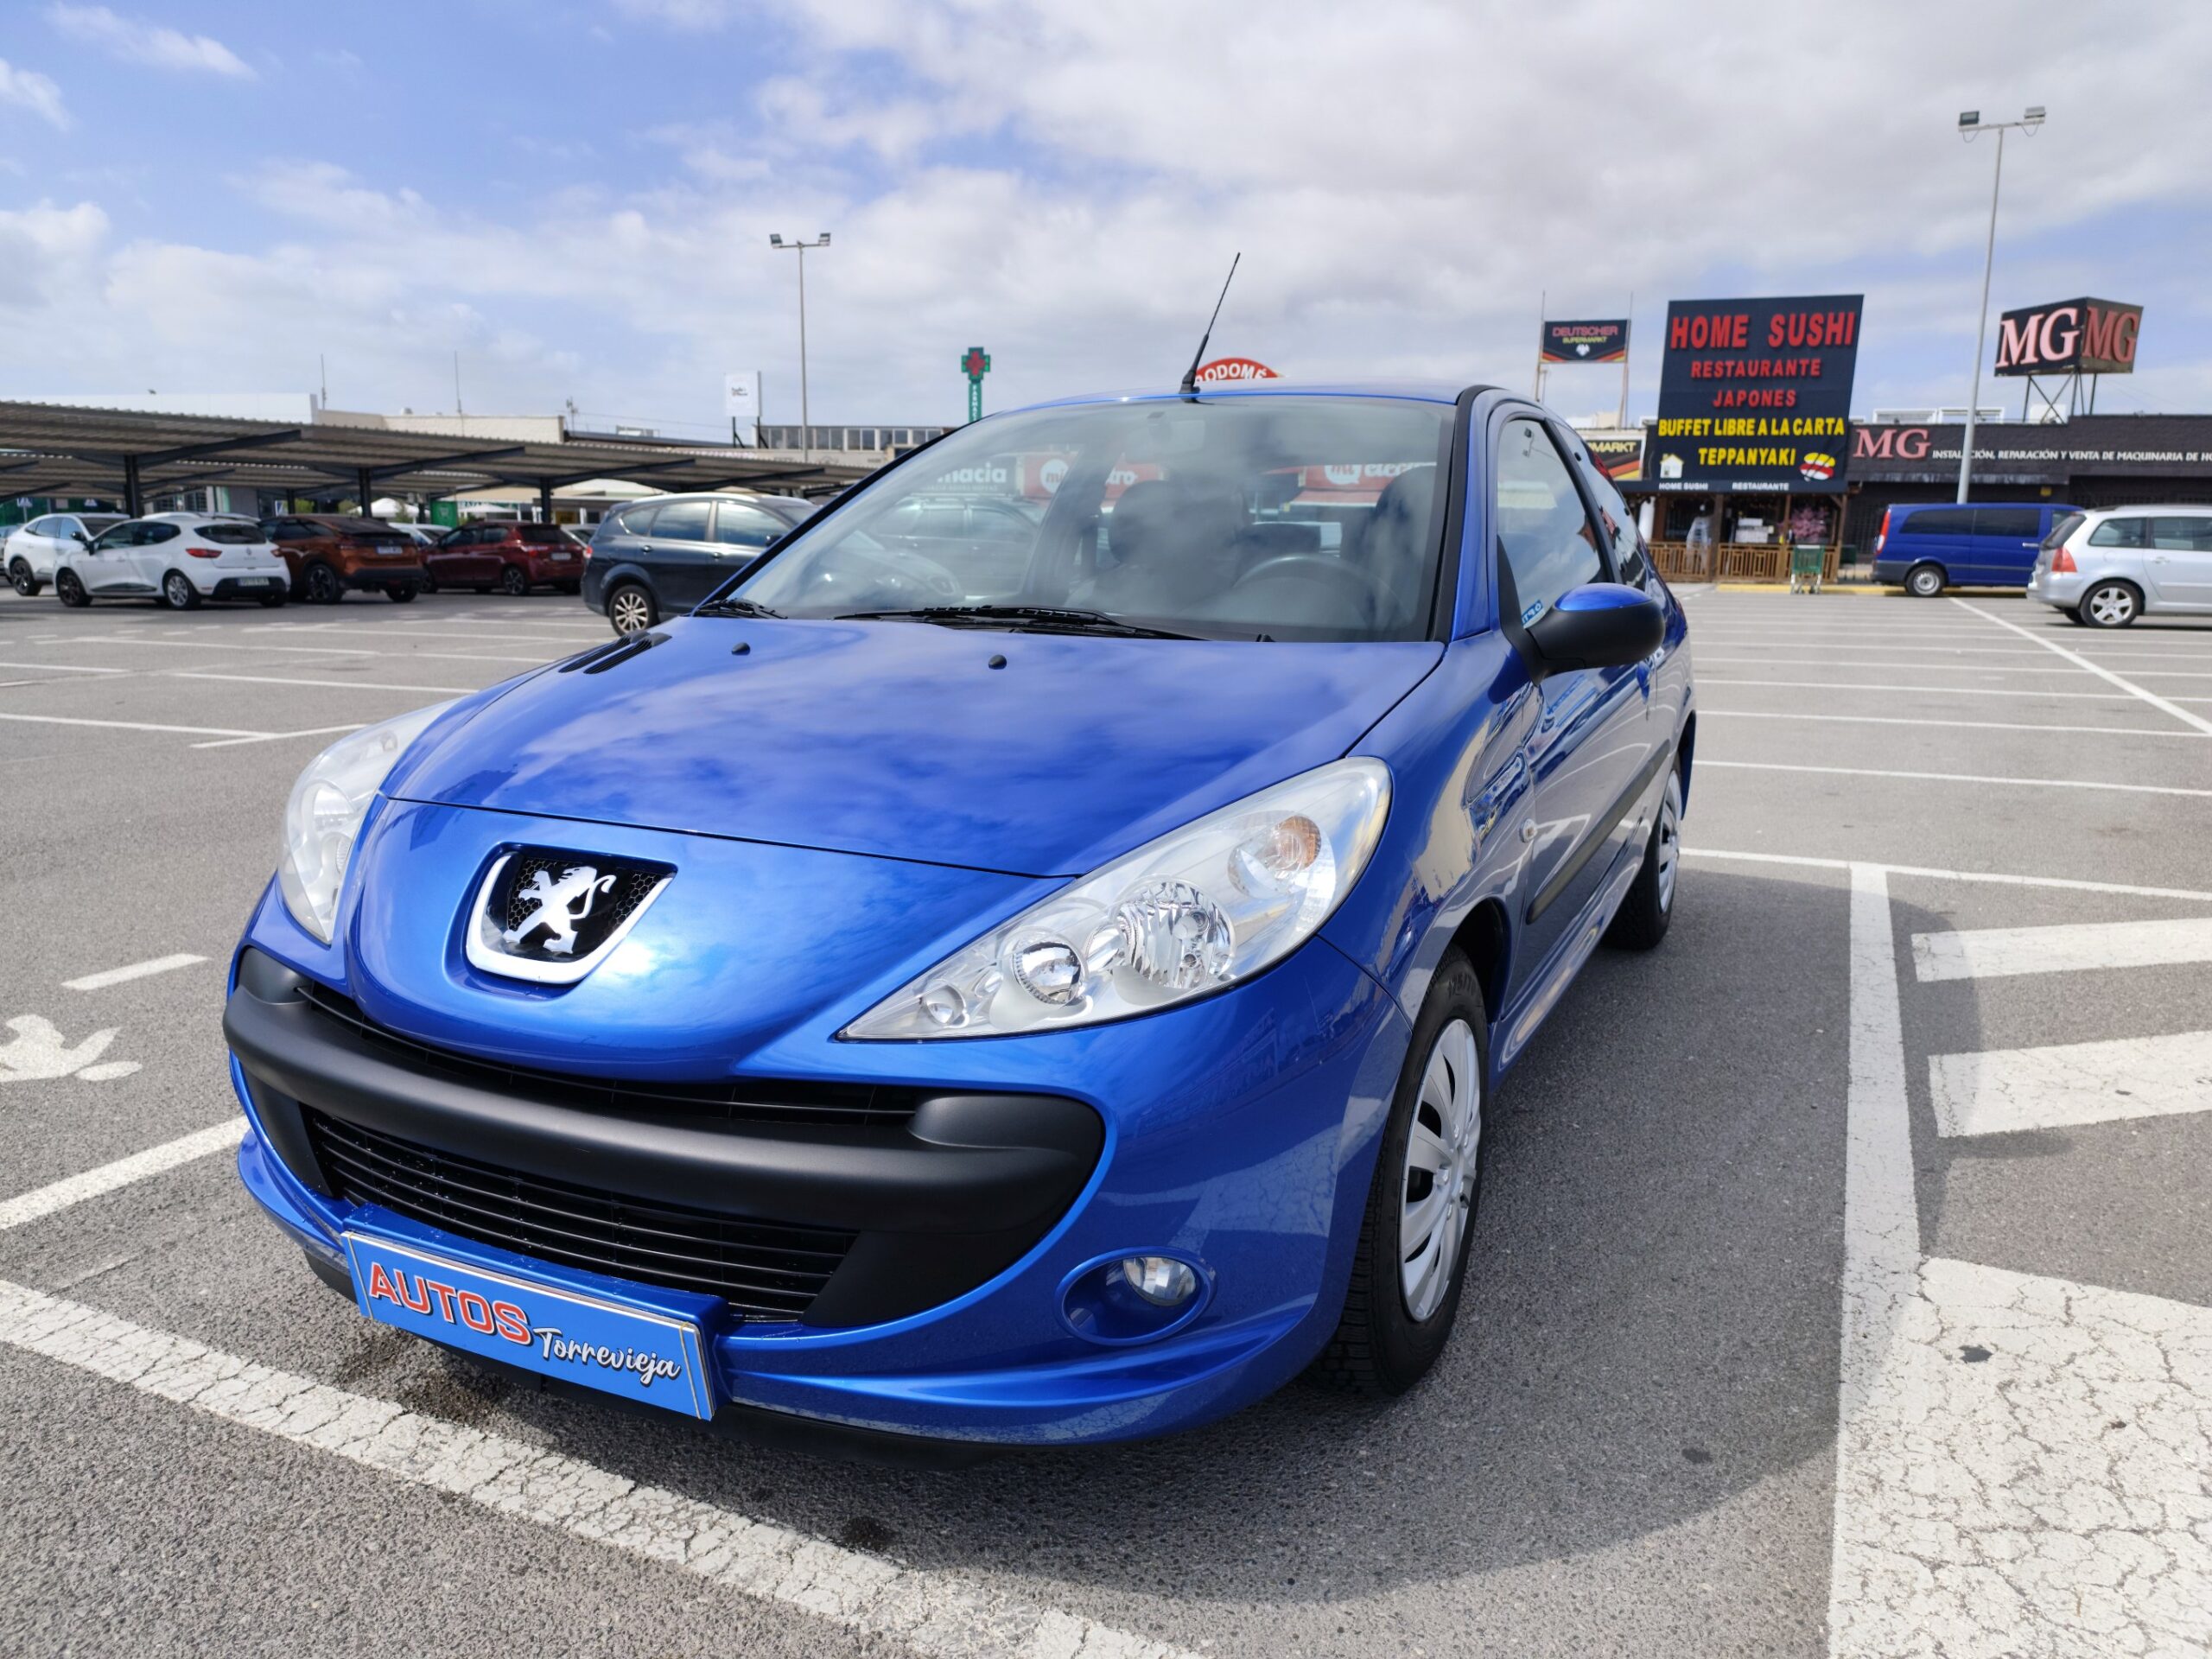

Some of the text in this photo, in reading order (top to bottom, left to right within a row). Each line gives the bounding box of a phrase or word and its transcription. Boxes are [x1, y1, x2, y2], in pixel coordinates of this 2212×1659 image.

[1552, 325, 1618, 337] DEUTSCHER
[1670, 312, 1856, 349] HOME SUSHI
[1995, 307, 2081, 368] MG
[2082, 306, 2139, 363] MG
[1690, 358, 1821, 378] RESTAURANTE
[1712, 389, 1796, 408] JAPONES
[1658, 417, 1845, 436] BUFFET LIBRE A LA CARTA
[1853, 428, 1932, 460] MG
[1698, 448, 1796, 466] TEPPANYAKI
[1932, 448, 1996, 460] INSTALCIÓN,
[1998, 448, 2059, 461] REPARACIÓN
[2061, 450, 2068, 460] Y
[2069, 450, 2100, 461] VENTA
[2101, 451, 2114, 461] DE
[2117, 451, 2183, 462] MAQUINARIA
[2185, 452, 2199, 461] DE
[1732, 481, 1789, 491] RESTAURANTE
[369, 1262, 681, 1385] AUTOS Torrevieja
